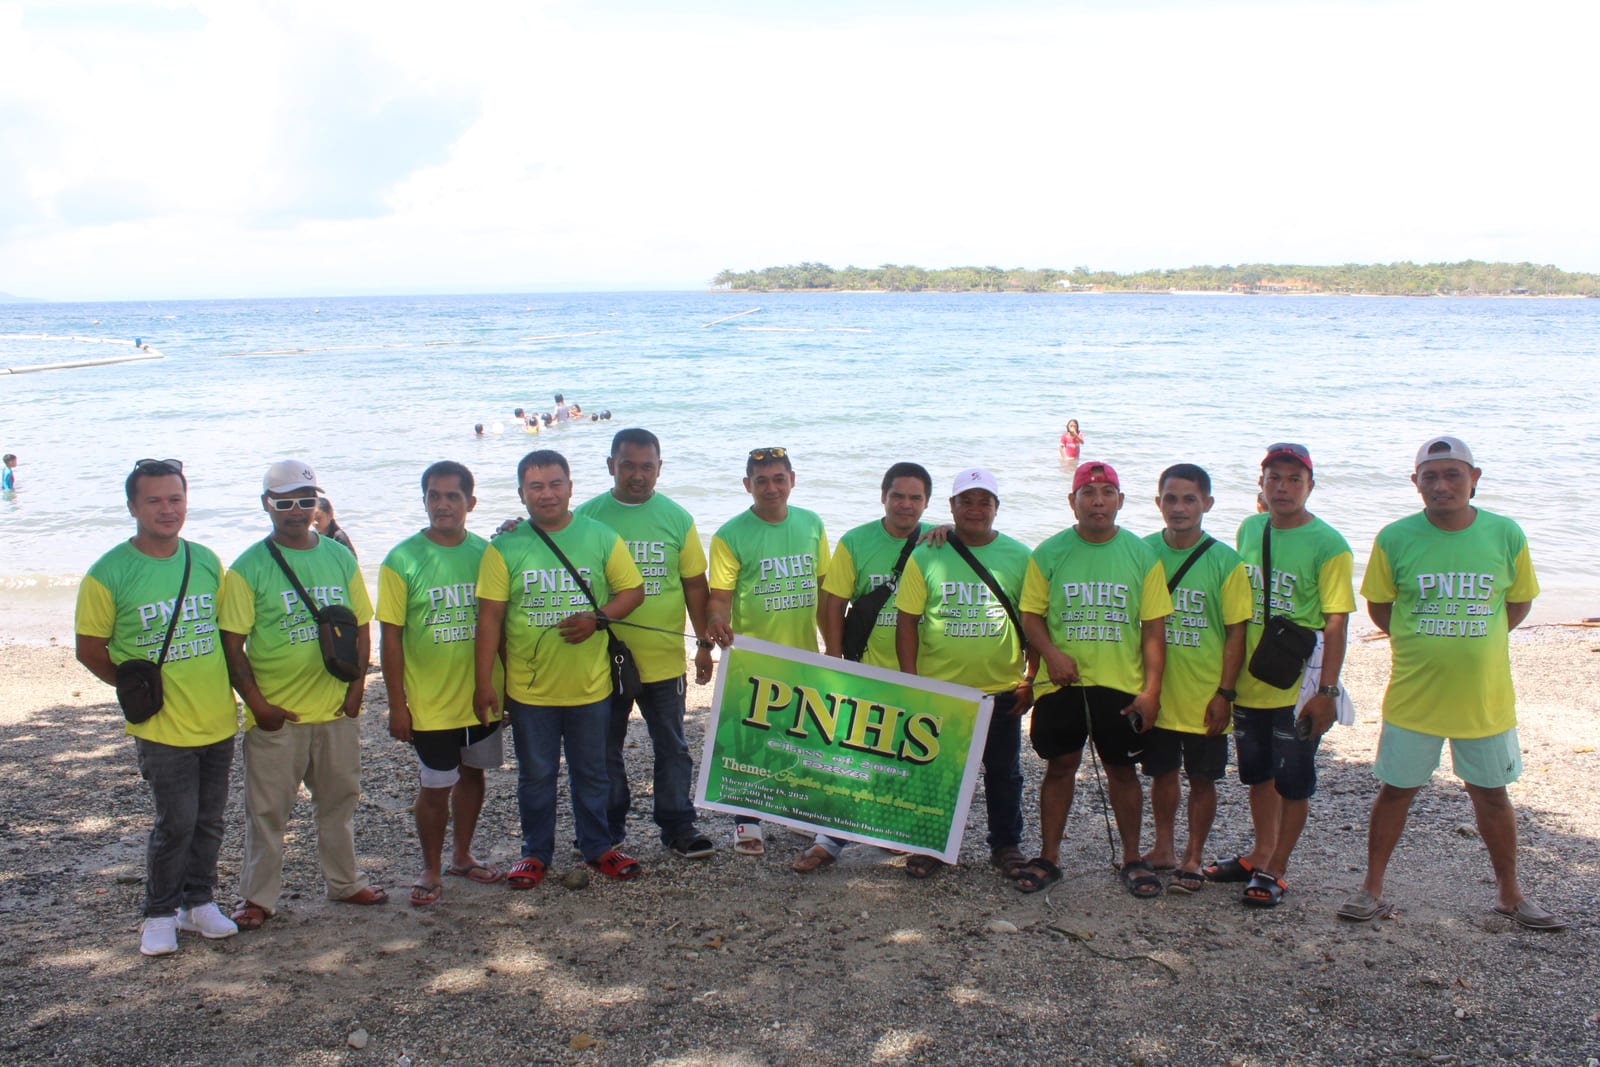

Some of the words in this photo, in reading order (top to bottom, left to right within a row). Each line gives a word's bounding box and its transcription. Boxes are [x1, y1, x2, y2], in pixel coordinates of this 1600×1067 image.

[760, 554, 813, 582] PNHS
[522, 568, 591, 594] PNHS
[754, 582, 781, 595] CLASS
[786, 581, 796, 591] OF
[1417, 572, 1494, 600] PNHS
[428, 583, 476, 612] PNH
[520, 596, 544, 608] LASS
[551, 596, 563, 606] OF
[941, 582, 1000, 606] PNH
[1063, 582, 1128, 609] PNHS
[1174, 588, 1206, 614] HS
[138, 594, 214, 632] PNHS
[424, 612, 451, 626] CLASS
[456, 610, 467, 622] OF
[967, 608, 978, 618] OF
[1087, 610, 1098, 621] OF
[1446, 602, 1460, 615] OF
[434, 624, 476, 644] FOREV
[1166, 628, 1200, 647] EVER
[1416, 618, 1487, 637] FOREVER
[742, 676, 943, 764] PNHS
[722, 757, 771, 778] Theme:
[802, 760, 870, 780] FOREVER
[832, 756, 852, 766] of
